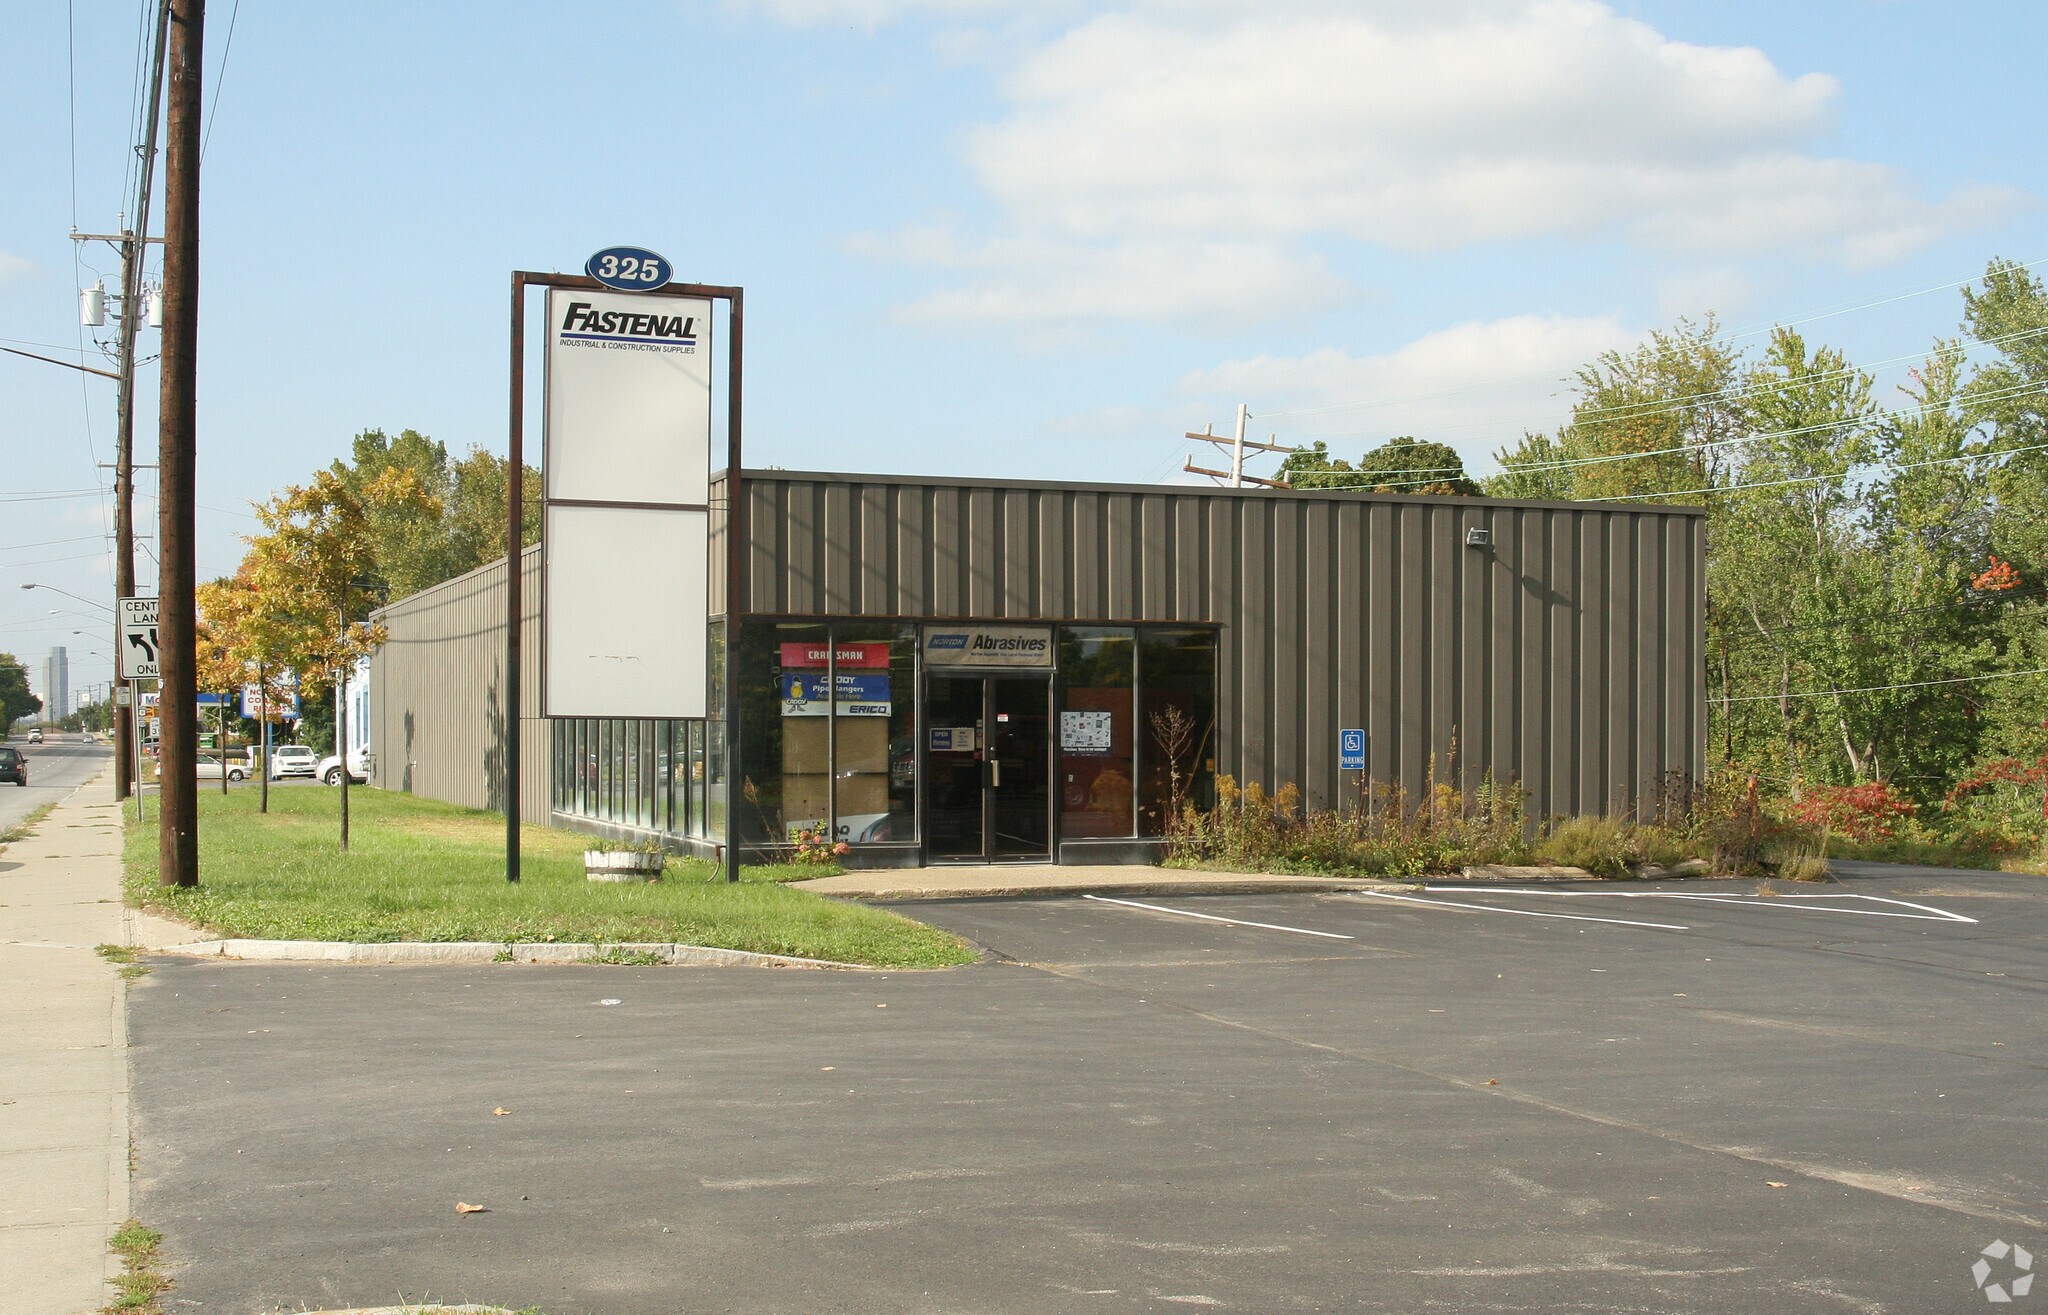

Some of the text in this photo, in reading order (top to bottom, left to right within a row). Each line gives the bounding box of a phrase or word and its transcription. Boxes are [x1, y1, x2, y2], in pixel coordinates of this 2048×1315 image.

[599, 255, 659, 283] 325
[562, 302, 697, 338] FASTENAL
[559, 339, 601, 349] INDUSTRIAL
[608, 342, 662, 352] CONSTRUCTION
[662, 345, 695, 355] SUPPLIES
[126, 602, 159, 611] CENT
[134, 613, 159, 623] LAN
[972, 634, 1047, 651] Abrasives
[808, 650, 863, 660] CRASMAN
[137, 665, 159, 674] ONL
[820, 676, 856, 684] CDDY
[849, 705, 887, 714] ERICO
